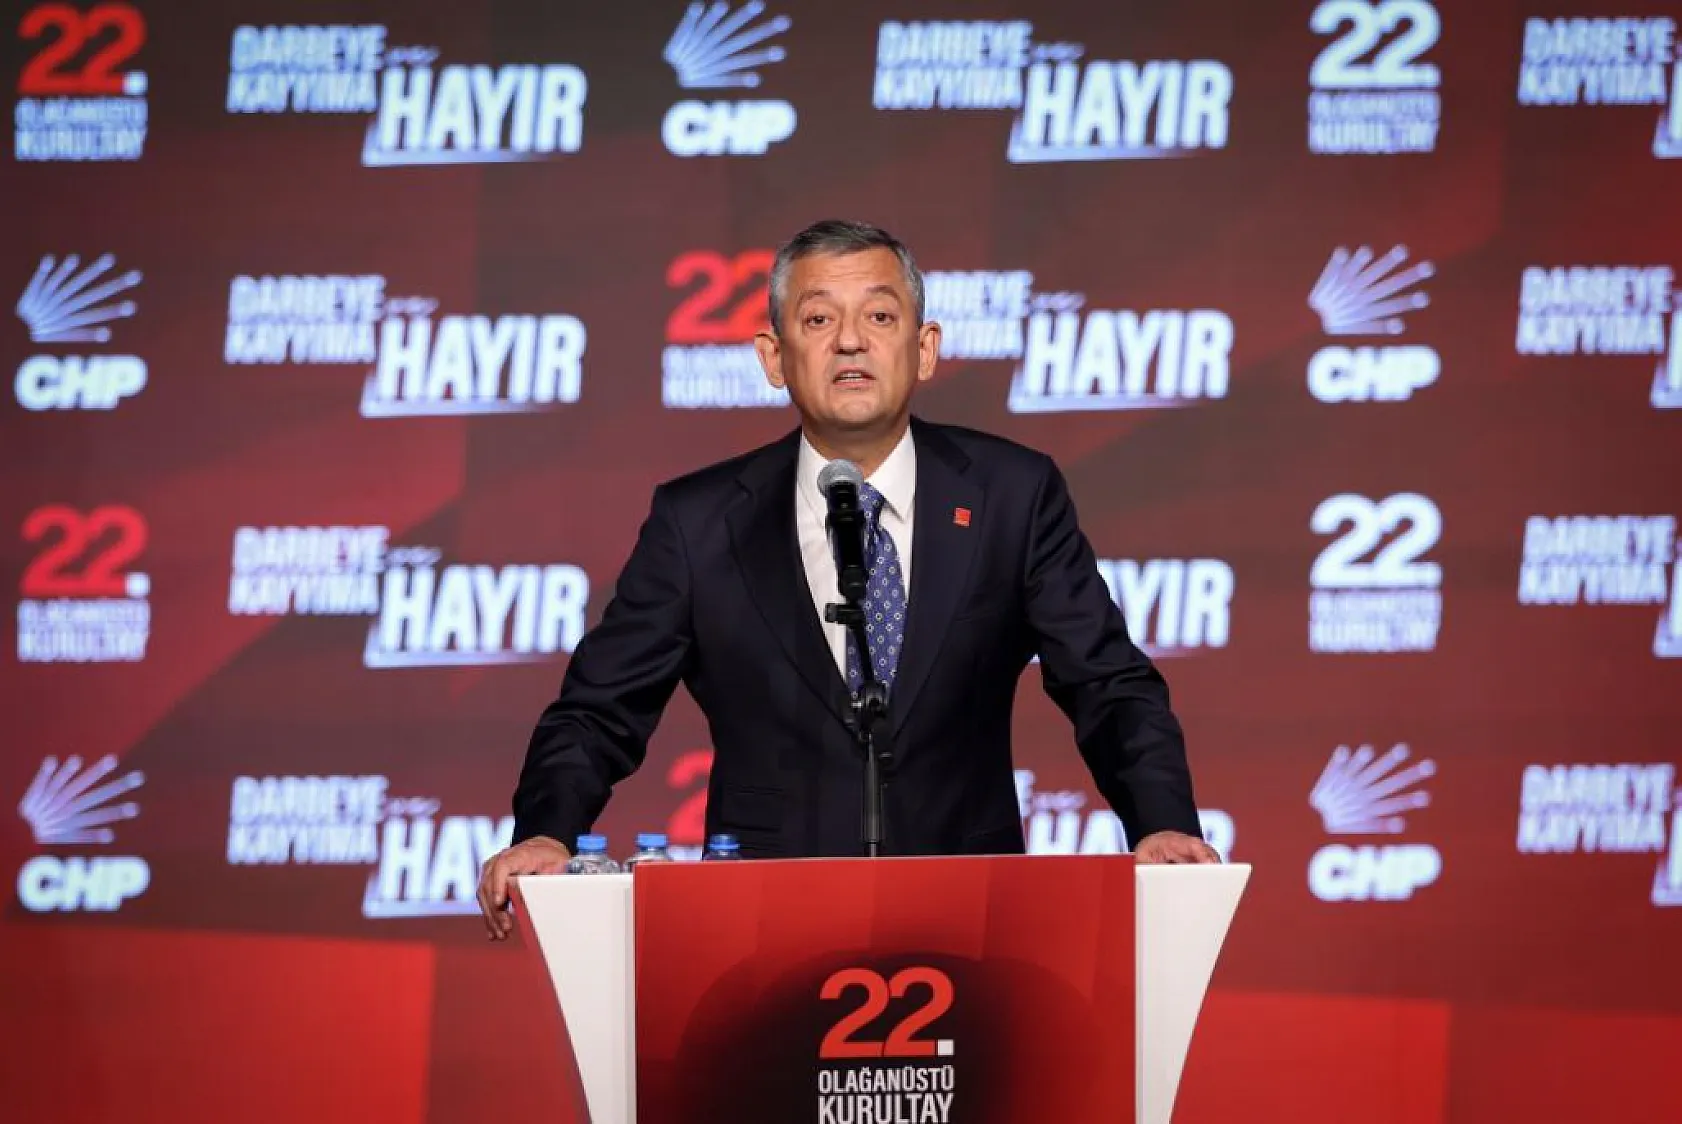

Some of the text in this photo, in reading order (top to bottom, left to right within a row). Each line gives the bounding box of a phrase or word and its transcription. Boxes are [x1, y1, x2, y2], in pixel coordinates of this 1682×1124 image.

[18, 4, 148, 96] 22.
[378, 63, 588, 153] HAYIR
[661, 100, 799, 157] CHP
[1024, 60, 1234, 150] HAYIR
[14, 355, 148, 411] CHP
[376, 314, 587, 404] HAYIR
[1025, 310, 1235, 400] HAYIR
[1306, 345, 1442, 403] CHP
[20, 505, 151, 598] 22.
[378, 564, 591, 654] HAYIR
[18, 856, 150, 912] CHP
[1306, 844, 1442, 901] CHP
[819, 967, 955, 1058] 22.
[818, 1065, 955, 1093] OLAĞANÜSTÜ
[818, 1092, 954, 1124] KURULTAY
